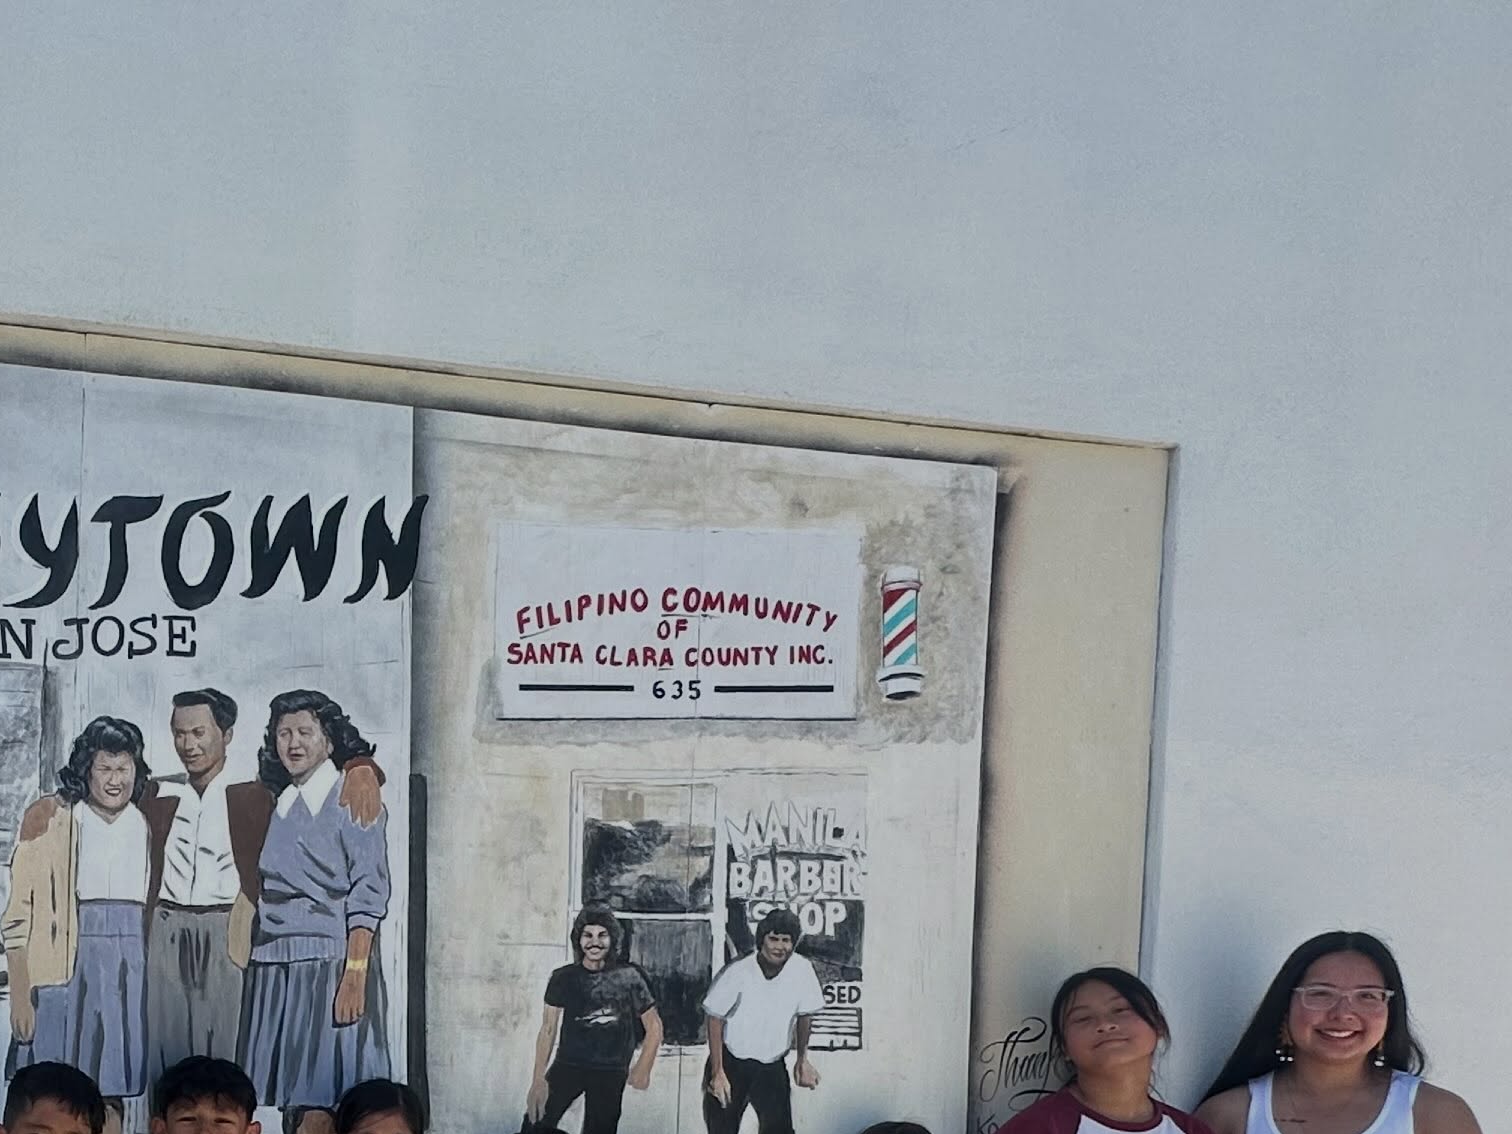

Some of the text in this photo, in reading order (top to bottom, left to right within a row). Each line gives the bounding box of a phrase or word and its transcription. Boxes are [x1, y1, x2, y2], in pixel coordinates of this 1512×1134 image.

[516, 586, 838, 635] FILIPINO COMMUNITY
[52, 613, 196, 660] JOSE
[657, 619, 688, 640] OF
[507, 642, 834, 667] SANTA CLARA COUNTY INC.
[652, 680, 702, 700] 635
[725, 800, 868, 858] MANILA
[729, 859, 862, 898] BARBER
[746, 901, 847, 937] SOP
